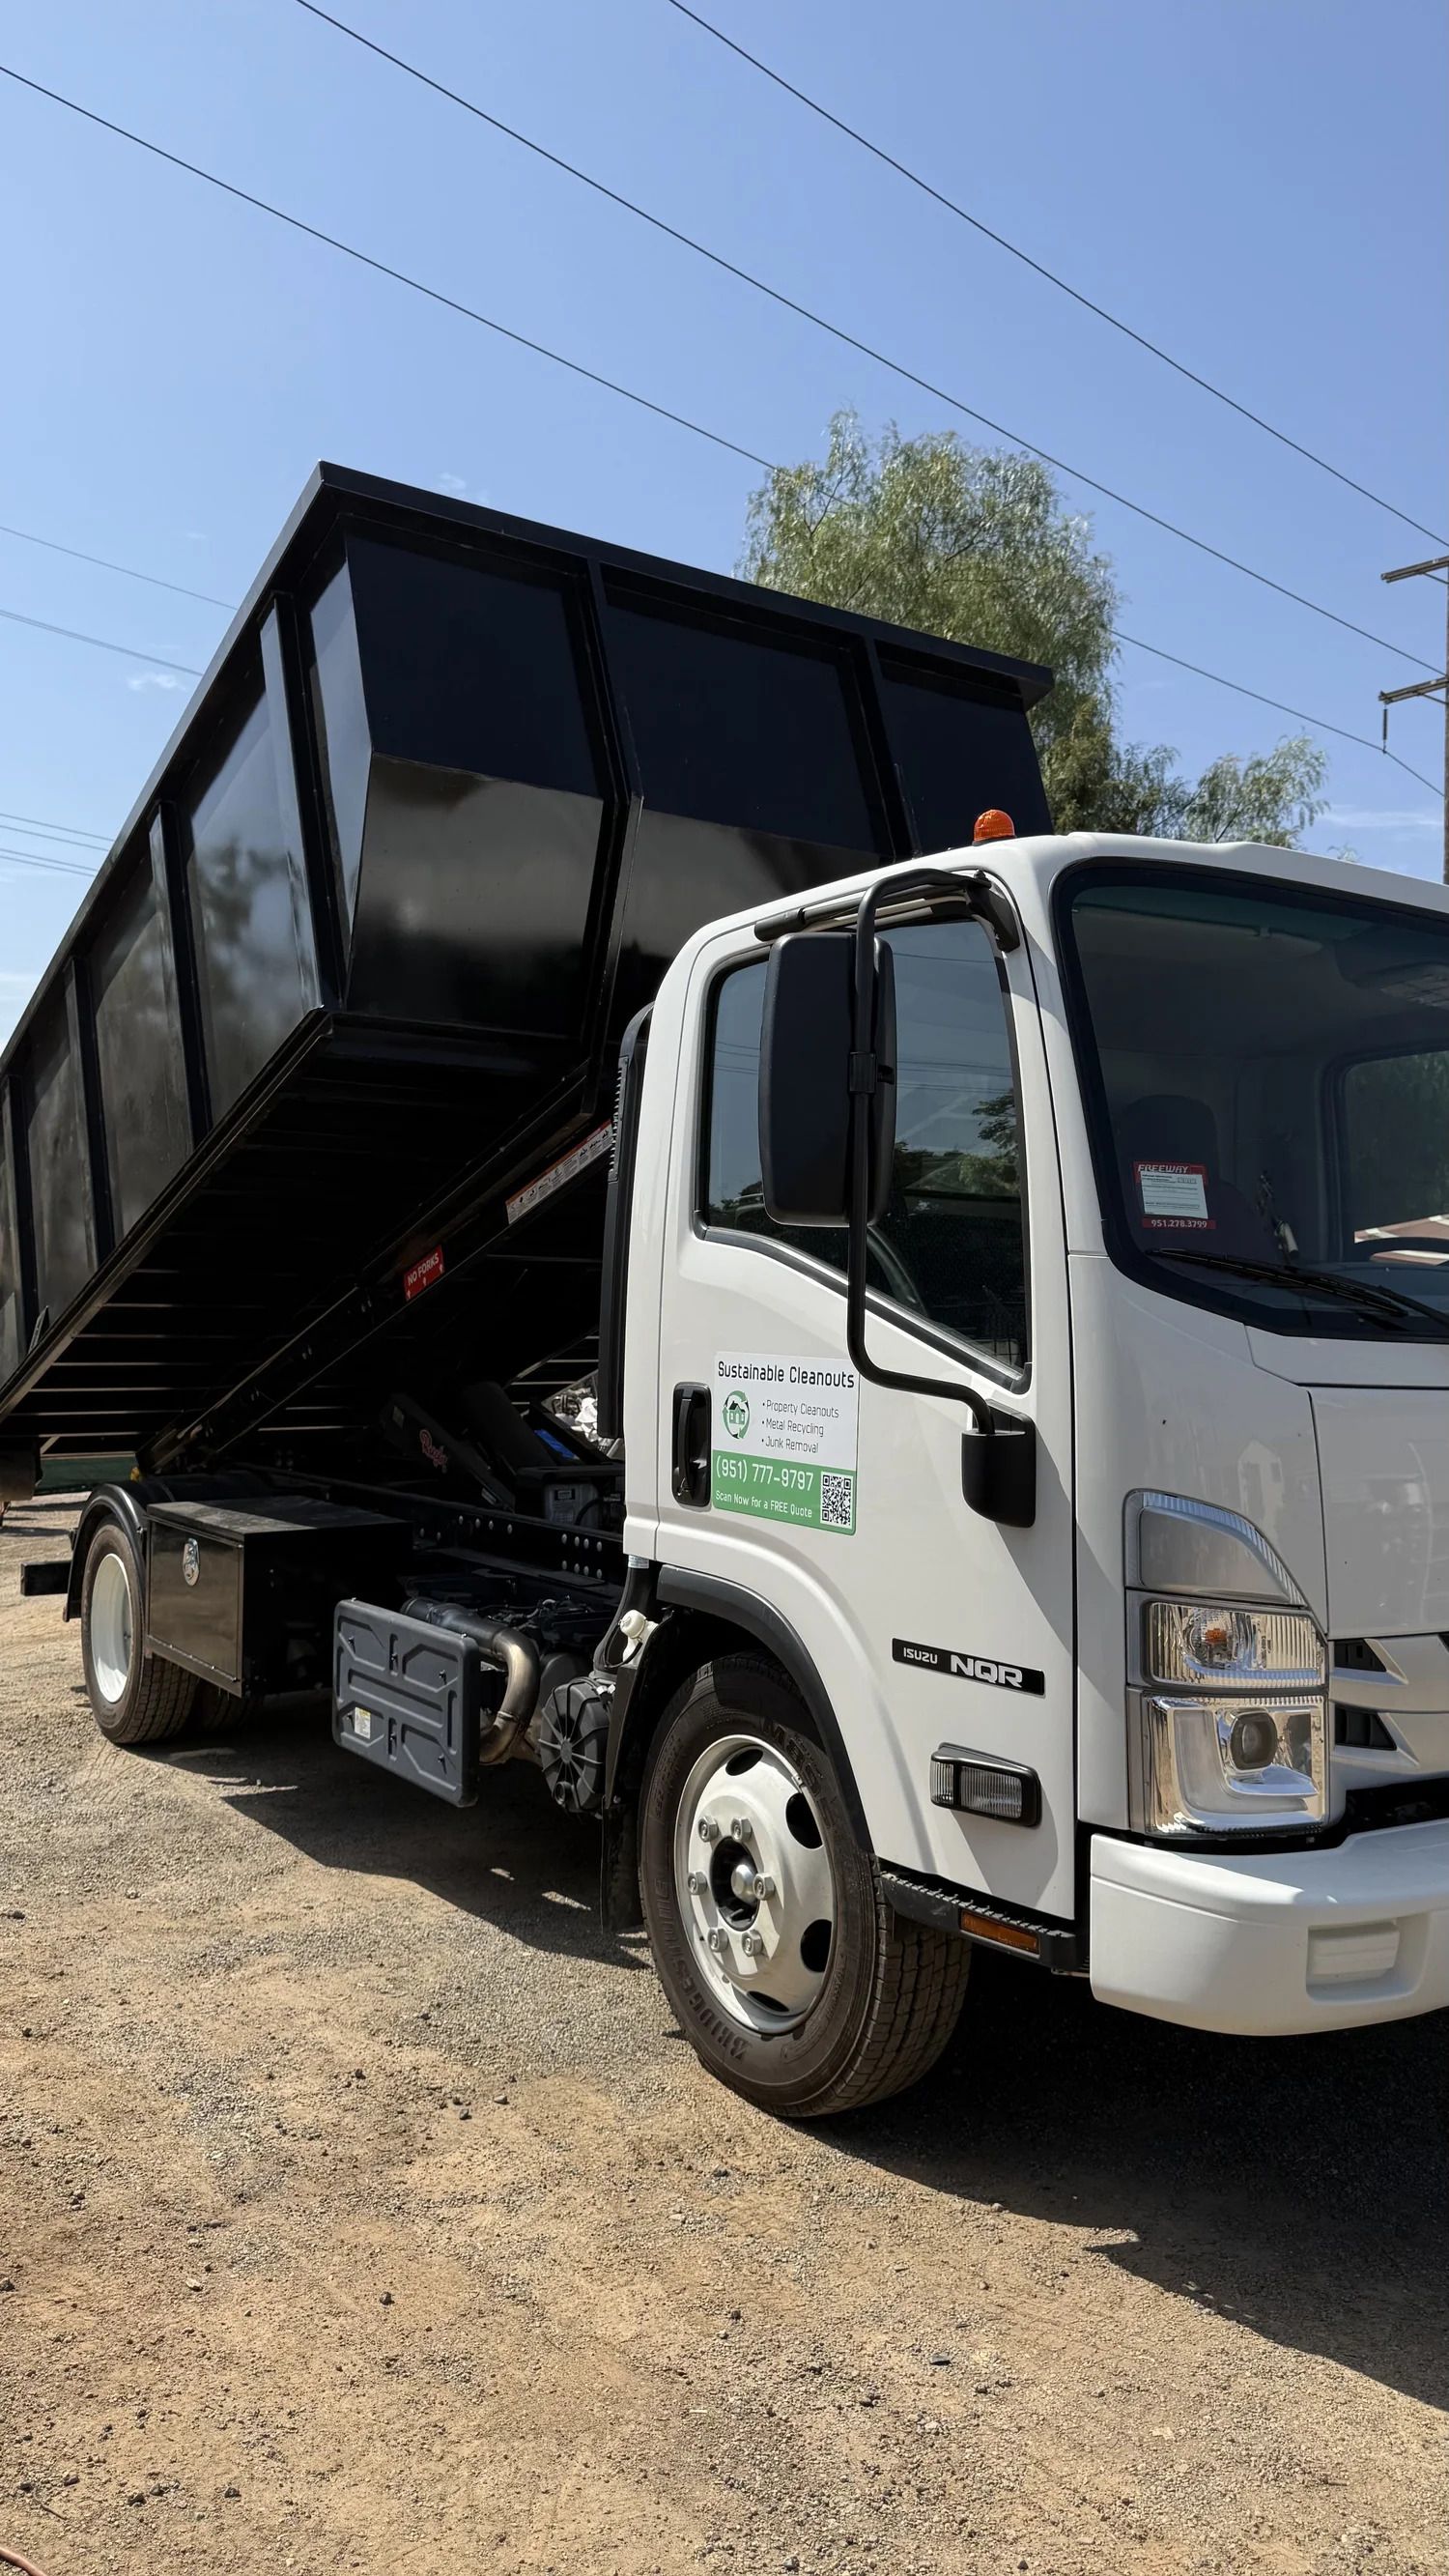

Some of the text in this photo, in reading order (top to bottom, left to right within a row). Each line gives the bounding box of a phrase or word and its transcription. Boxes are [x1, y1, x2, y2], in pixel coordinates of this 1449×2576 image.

[1138, 1164, 1189, 1173] FREEWAY
[1151, 1219, 1208, 1228] 951.278.3799
[407, 1252, 440, 1286] NO FORKS
[718, 1360, 855, 1388] Sustainable Cleanouts
[766, 1399, 839, 1418] Property Cleanouts
[765, 1418, 824, 1438] Metal Recycling
[765, 1436, 819, 1453] Junk Removal
[716, 1455, 814, 1492] (951) 777-9797
[715, 1490, 812, 1518] Scan Now for a FREE Quote
[903, 1646, 1023, 1688] ISUZU NQR
[762, 1717, 832, 1829] M895
[655, 1876, 753, 2061] BRIDGESTONE
